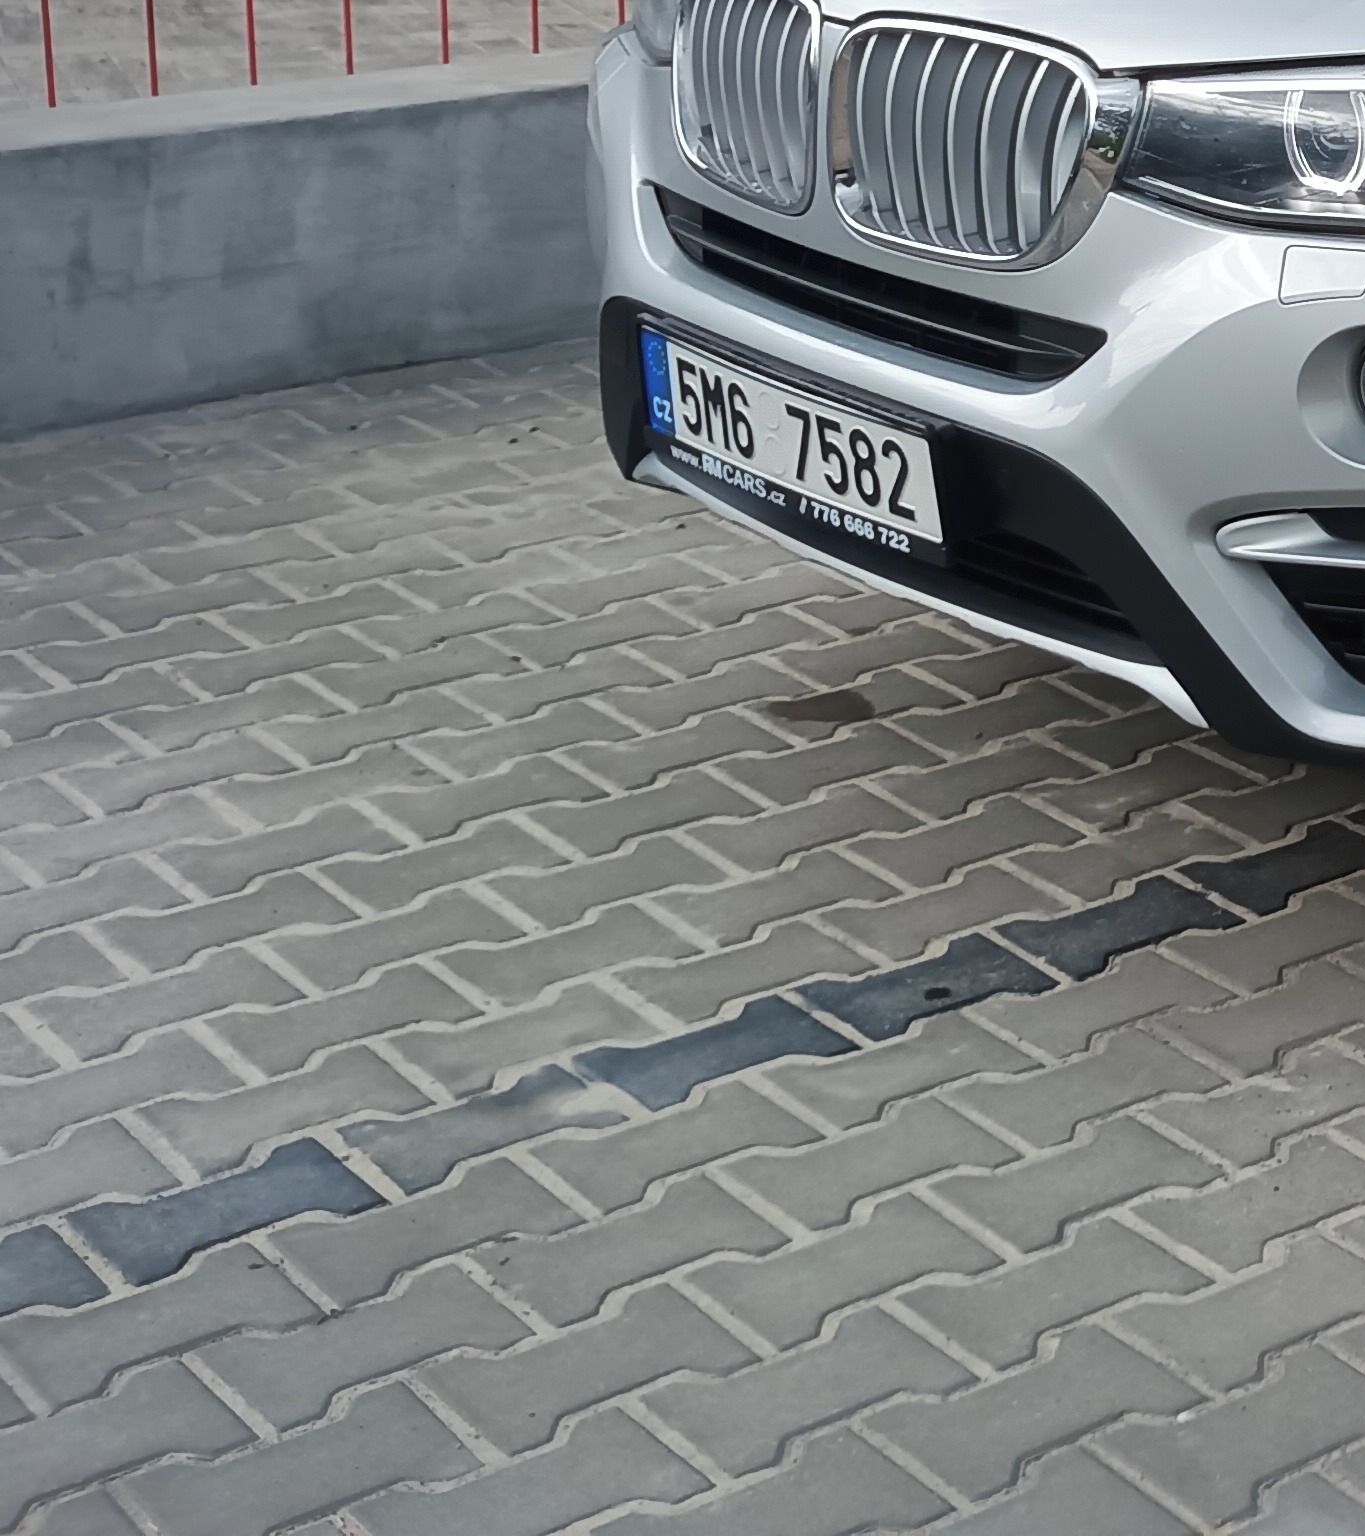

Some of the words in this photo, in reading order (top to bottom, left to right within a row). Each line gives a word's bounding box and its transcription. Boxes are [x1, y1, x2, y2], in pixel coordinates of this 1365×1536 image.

[653, 395, 673, 424] CZ
[676, 356, 755, 459] 5M6
[784, 402, 917, 522] 7582
[810, 501, 841, 527] 776
[878, 525, 911, 554] 722
